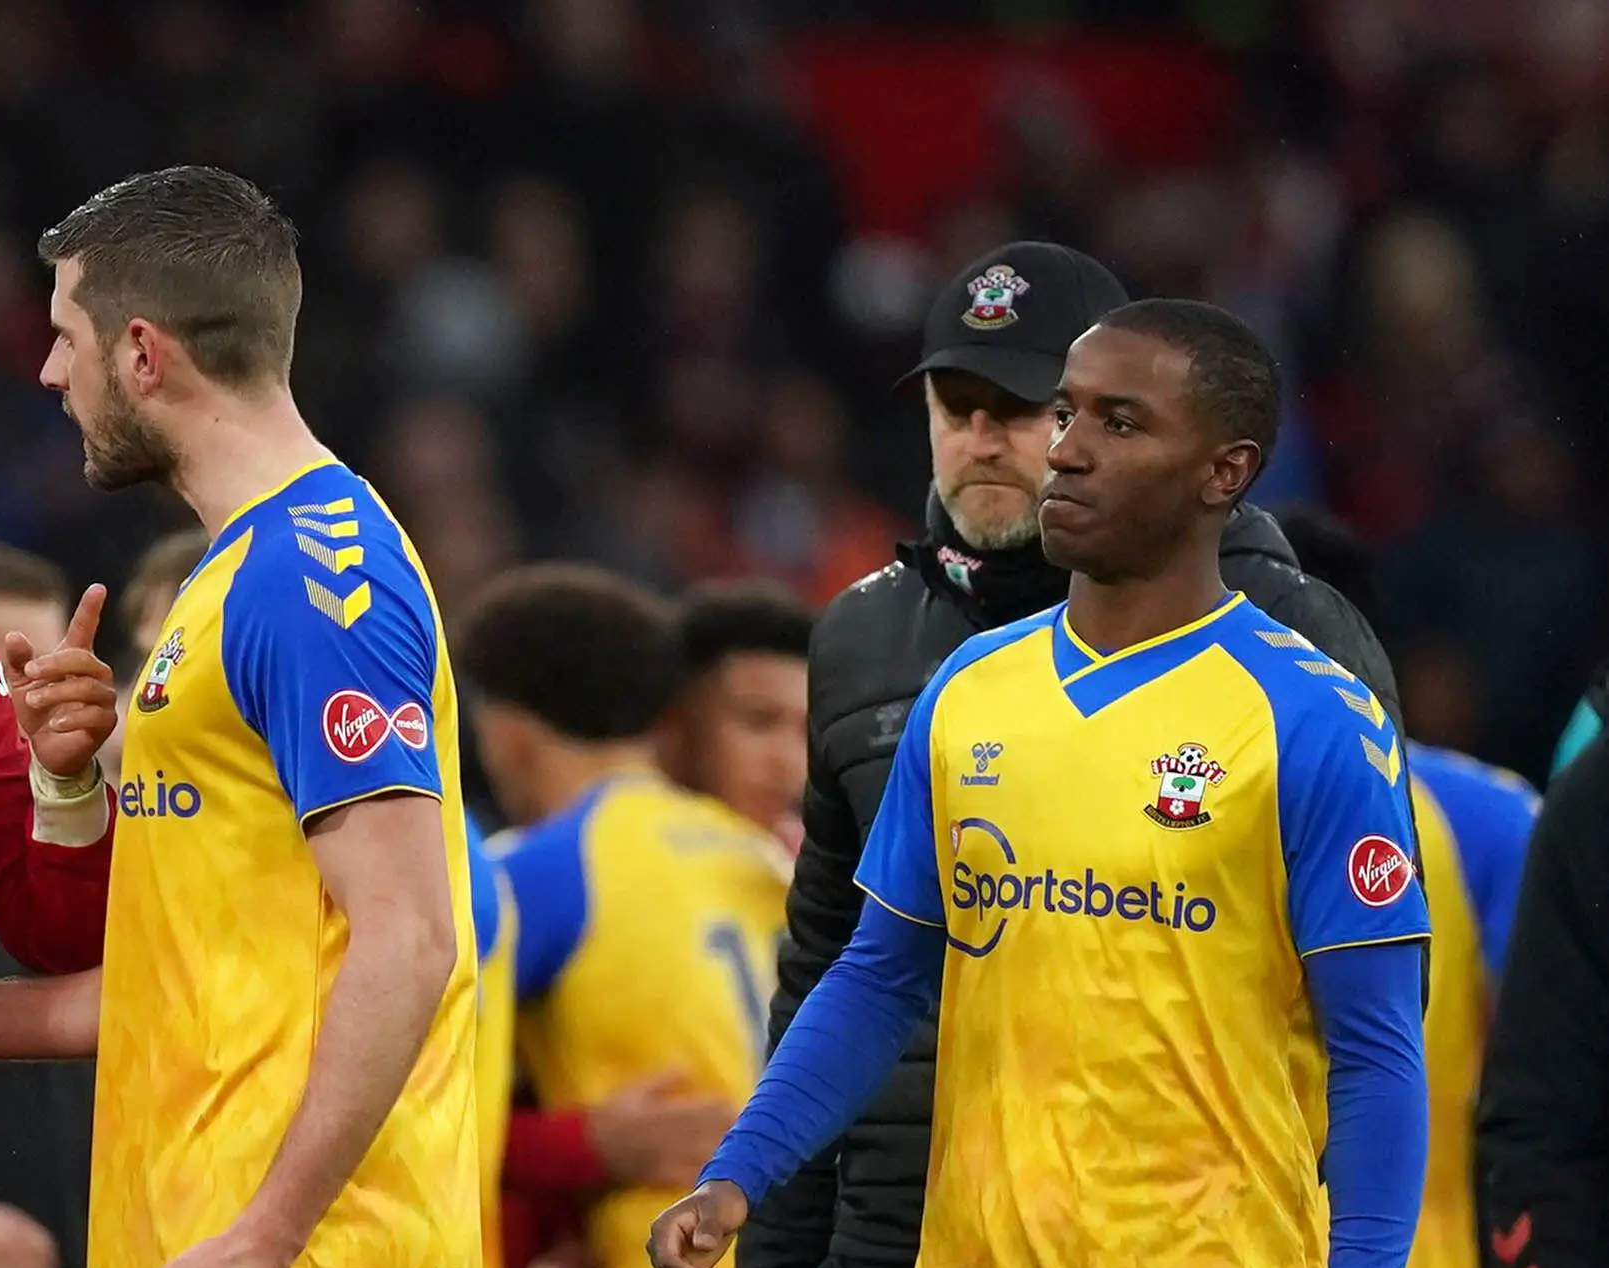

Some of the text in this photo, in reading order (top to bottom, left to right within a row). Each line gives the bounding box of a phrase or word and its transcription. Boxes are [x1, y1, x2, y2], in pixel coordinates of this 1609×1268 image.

[334, 703, 424, 748] Virgin media
[1358, 848, 1402, 893] Virgin
[951, 860, 1217, 933] Sportsbet.io
